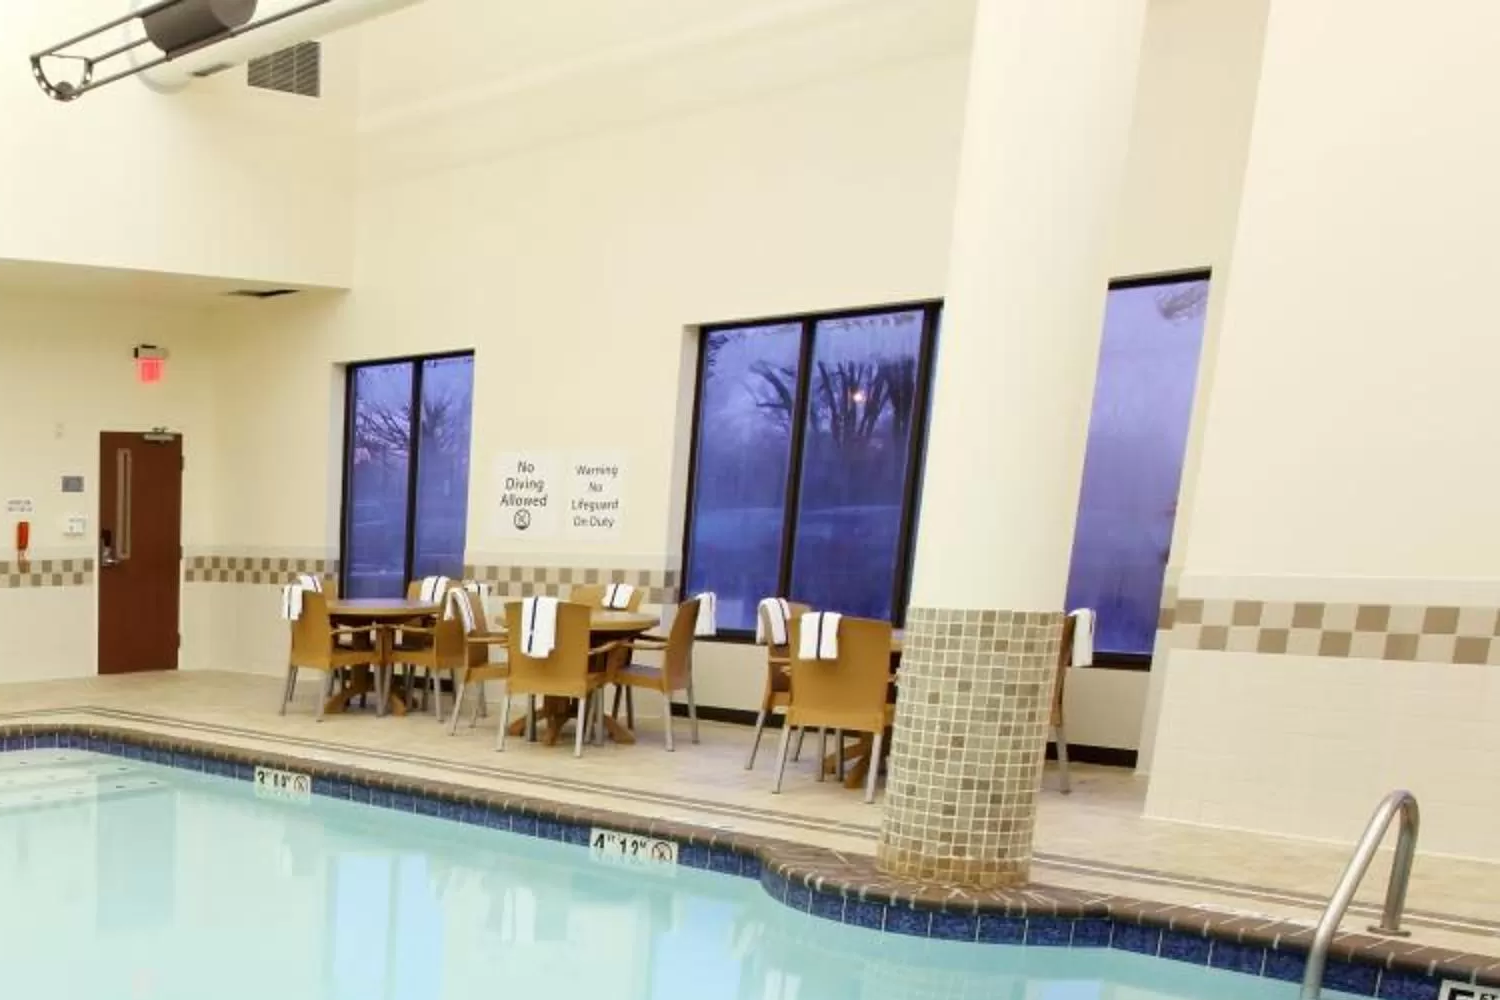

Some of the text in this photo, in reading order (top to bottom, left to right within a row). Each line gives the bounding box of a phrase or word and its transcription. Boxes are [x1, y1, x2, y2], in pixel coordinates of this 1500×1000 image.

[517, 460, 535, 474] No
[575, 464, 618, 478] Warning
[505, 477, 545, 493] Diving
[500, 494, 547, 507] Allowed
[571, 499, 619, 512] Lifeguard
[590, 516, 615, 528] Duty
